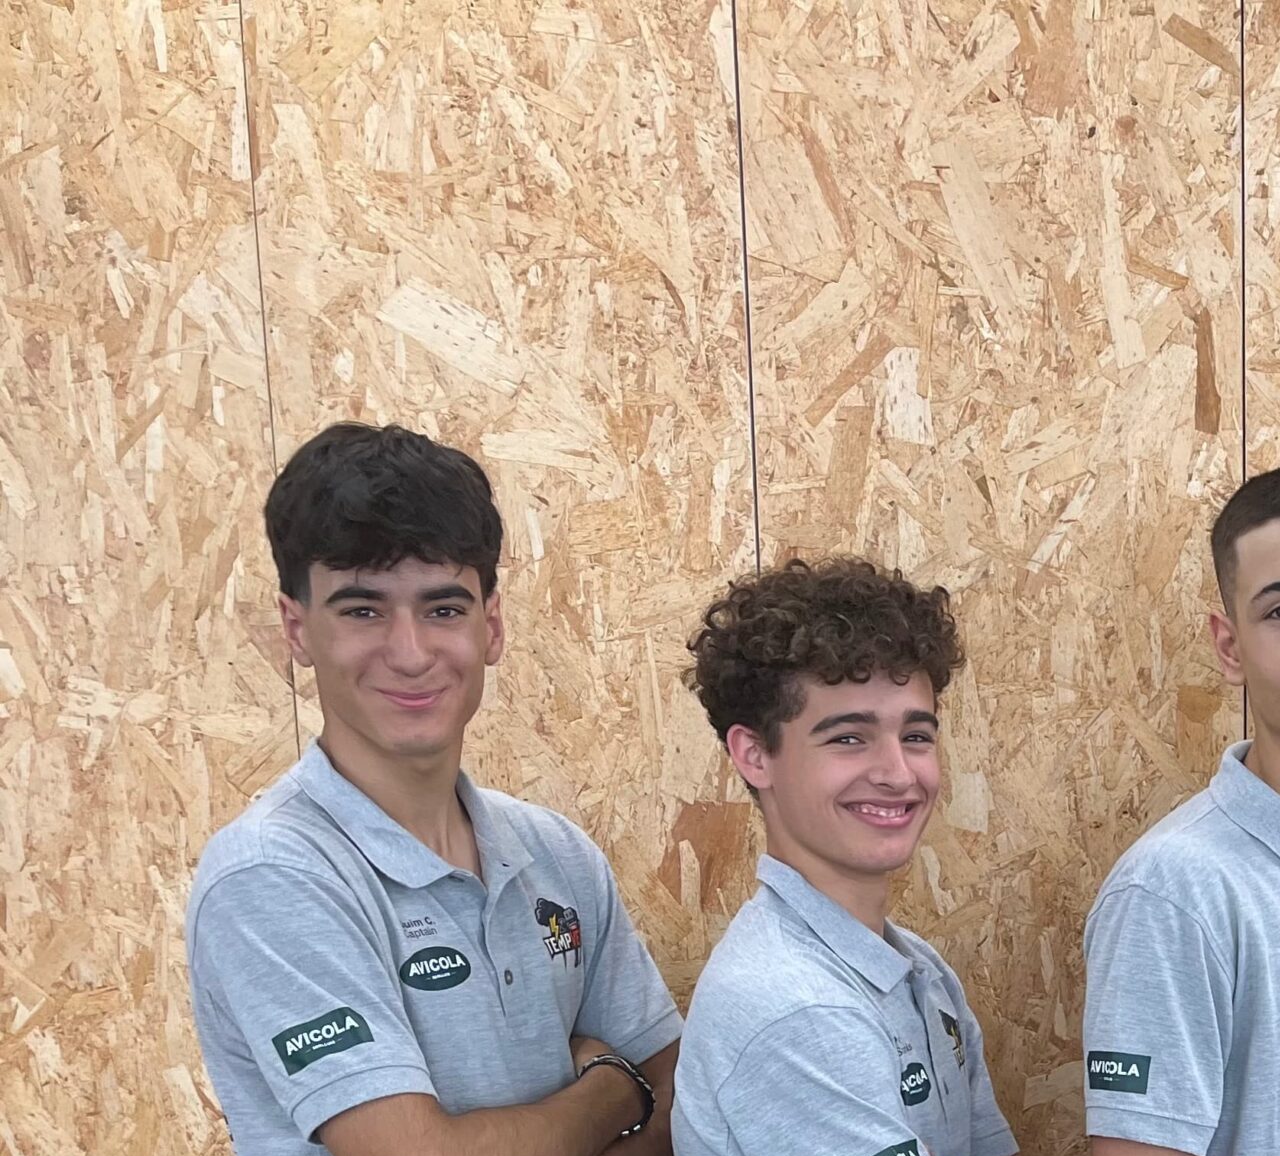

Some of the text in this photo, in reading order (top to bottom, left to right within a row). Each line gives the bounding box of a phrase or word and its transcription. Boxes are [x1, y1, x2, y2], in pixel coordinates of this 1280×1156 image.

[408, 954, 467, 977] AVICOLA
[285, 1015, 360, 1056] AVICOLA
[1090, 1060, 1140, 1078] AVICOLA
